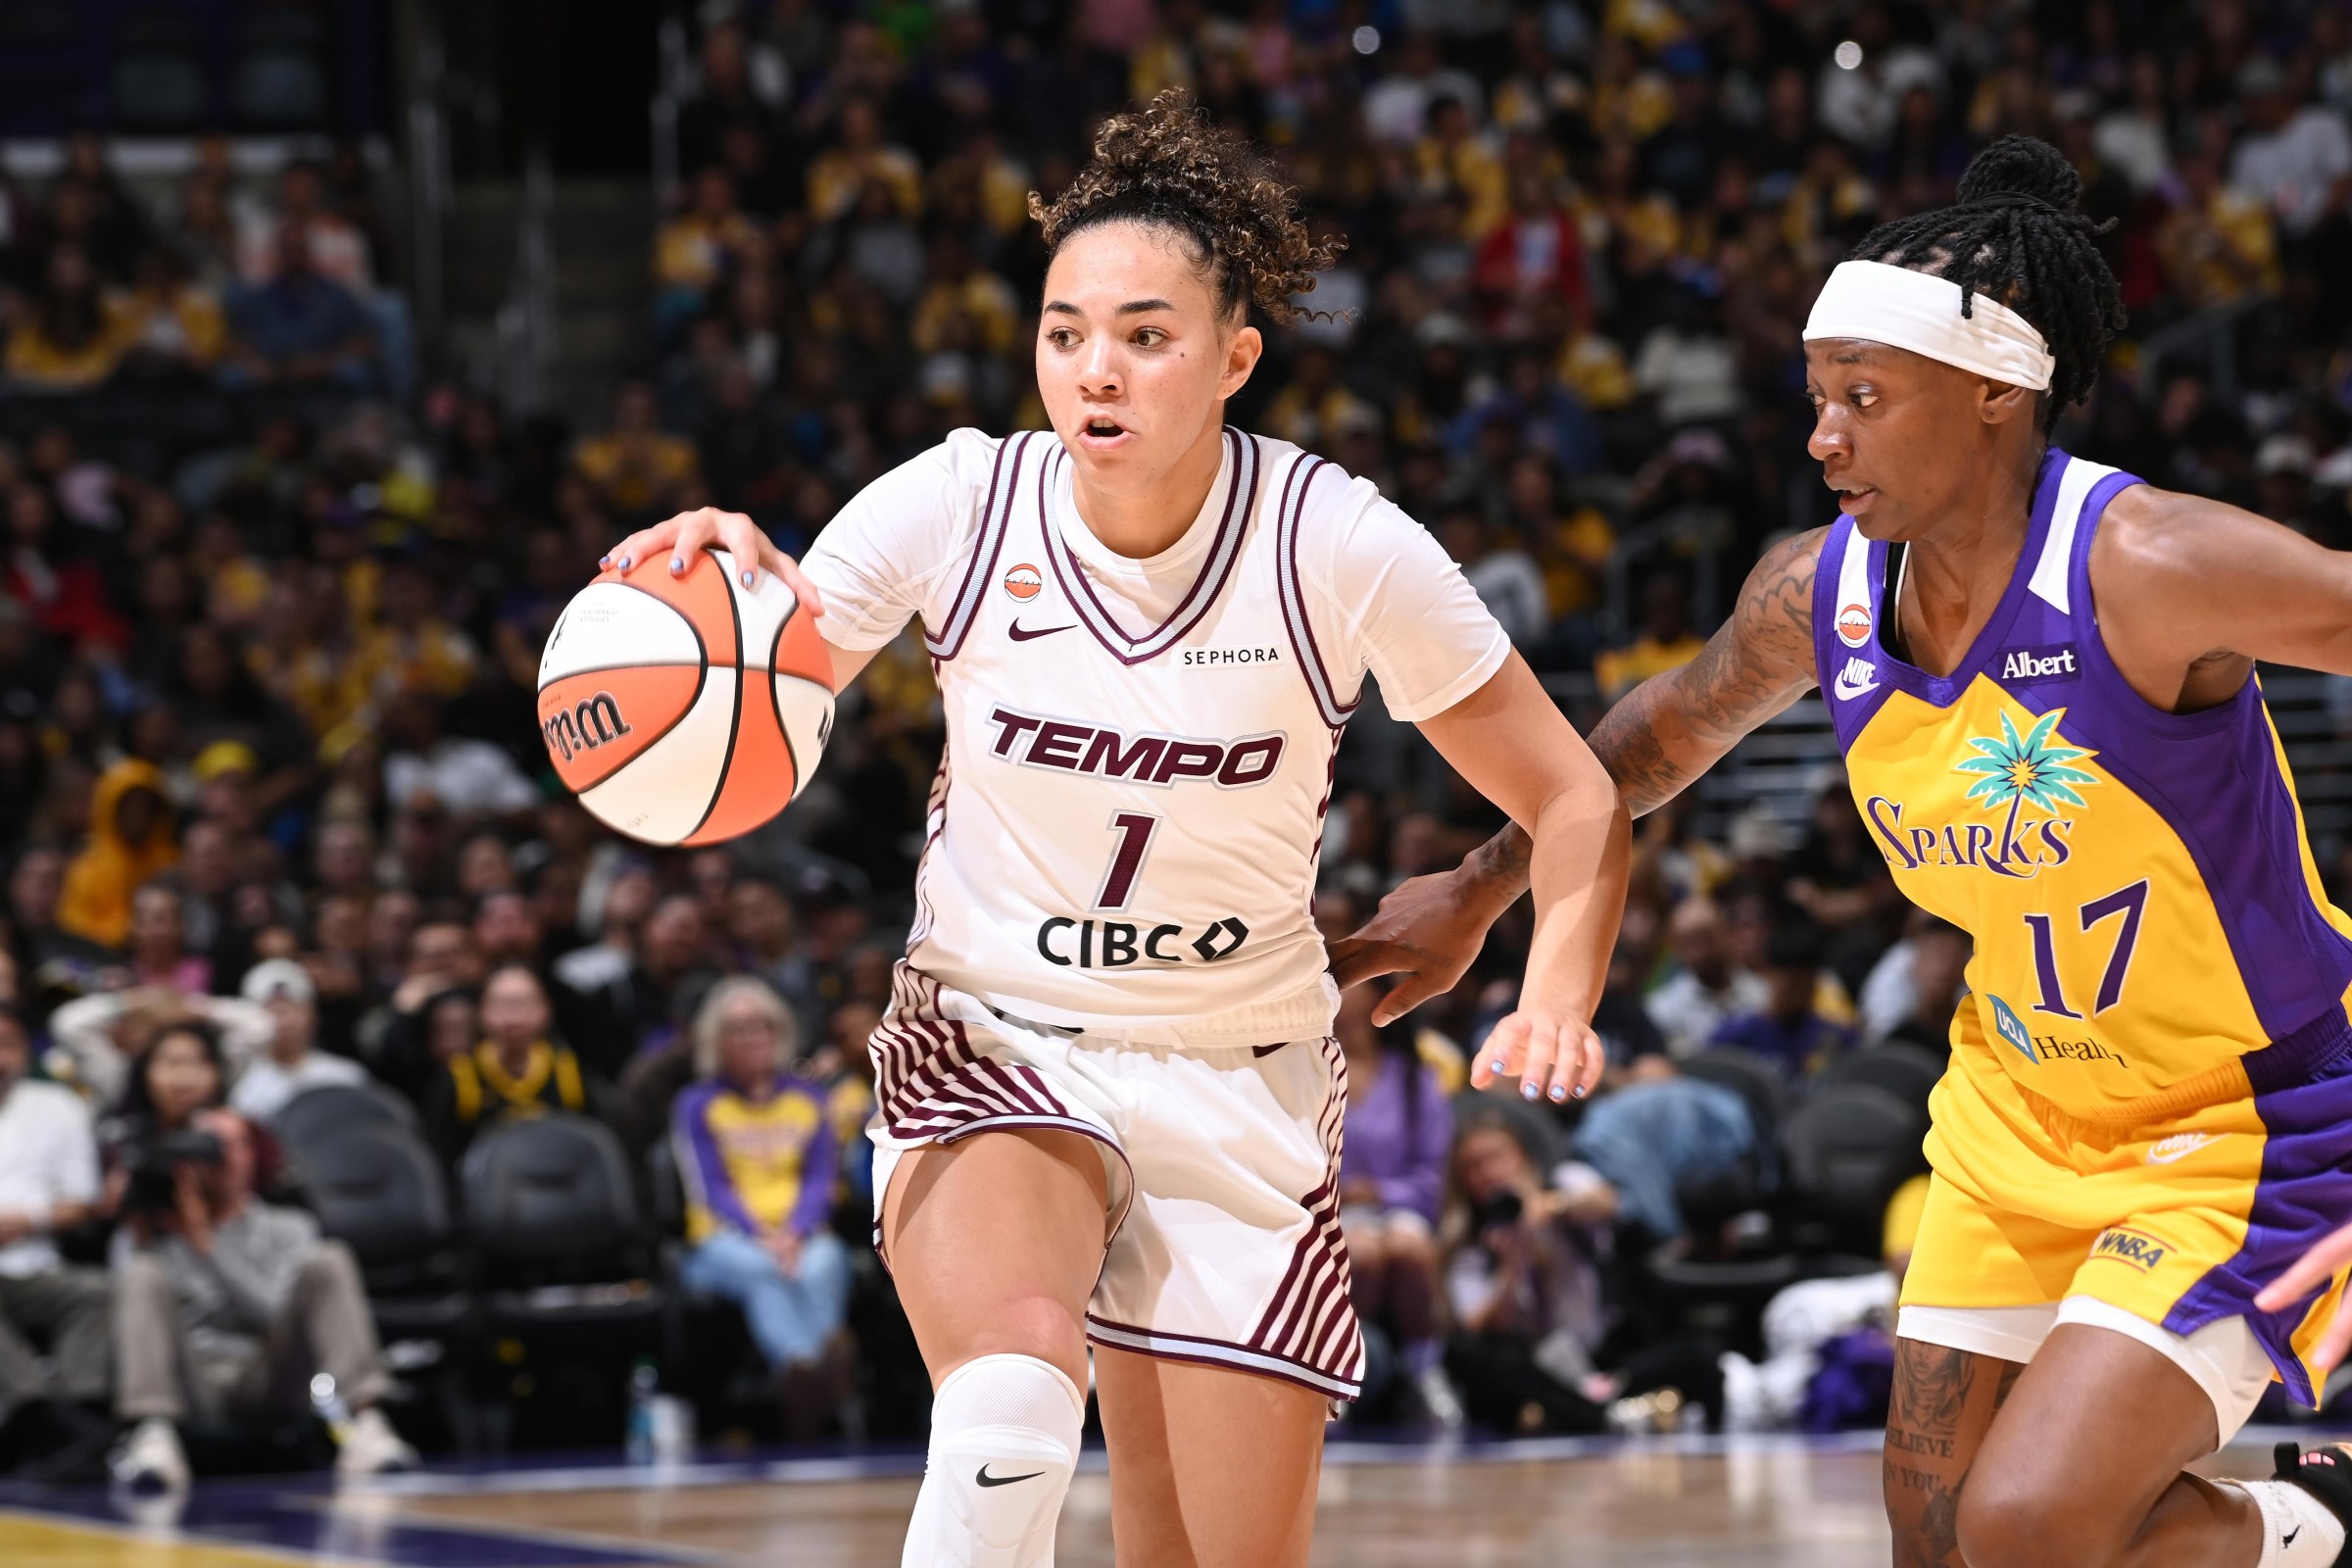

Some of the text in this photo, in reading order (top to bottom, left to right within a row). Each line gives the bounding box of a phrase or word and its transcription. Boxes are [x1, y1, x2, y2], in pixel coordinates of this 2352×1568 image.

[1184, 647, 1279, 665] SEPHORA
[1842, 656, 1876, 686] NIKE
[2002, 650, 2076, 679] Albert
[541, 690, 633, 762] Wils
[986, 702, 1288, 790] TEMPO
[1092, 810, 1160, 911] 1
[1037, 917, 1182, 968] CIBC
[2024, 877, 2149, 1021] 17
[1996, 1006, 2031, 1053] UCLA
[2097, 1232, 2165, 1268] WNBA
[1886, 1426, 1954, 1458] ELIEVE
